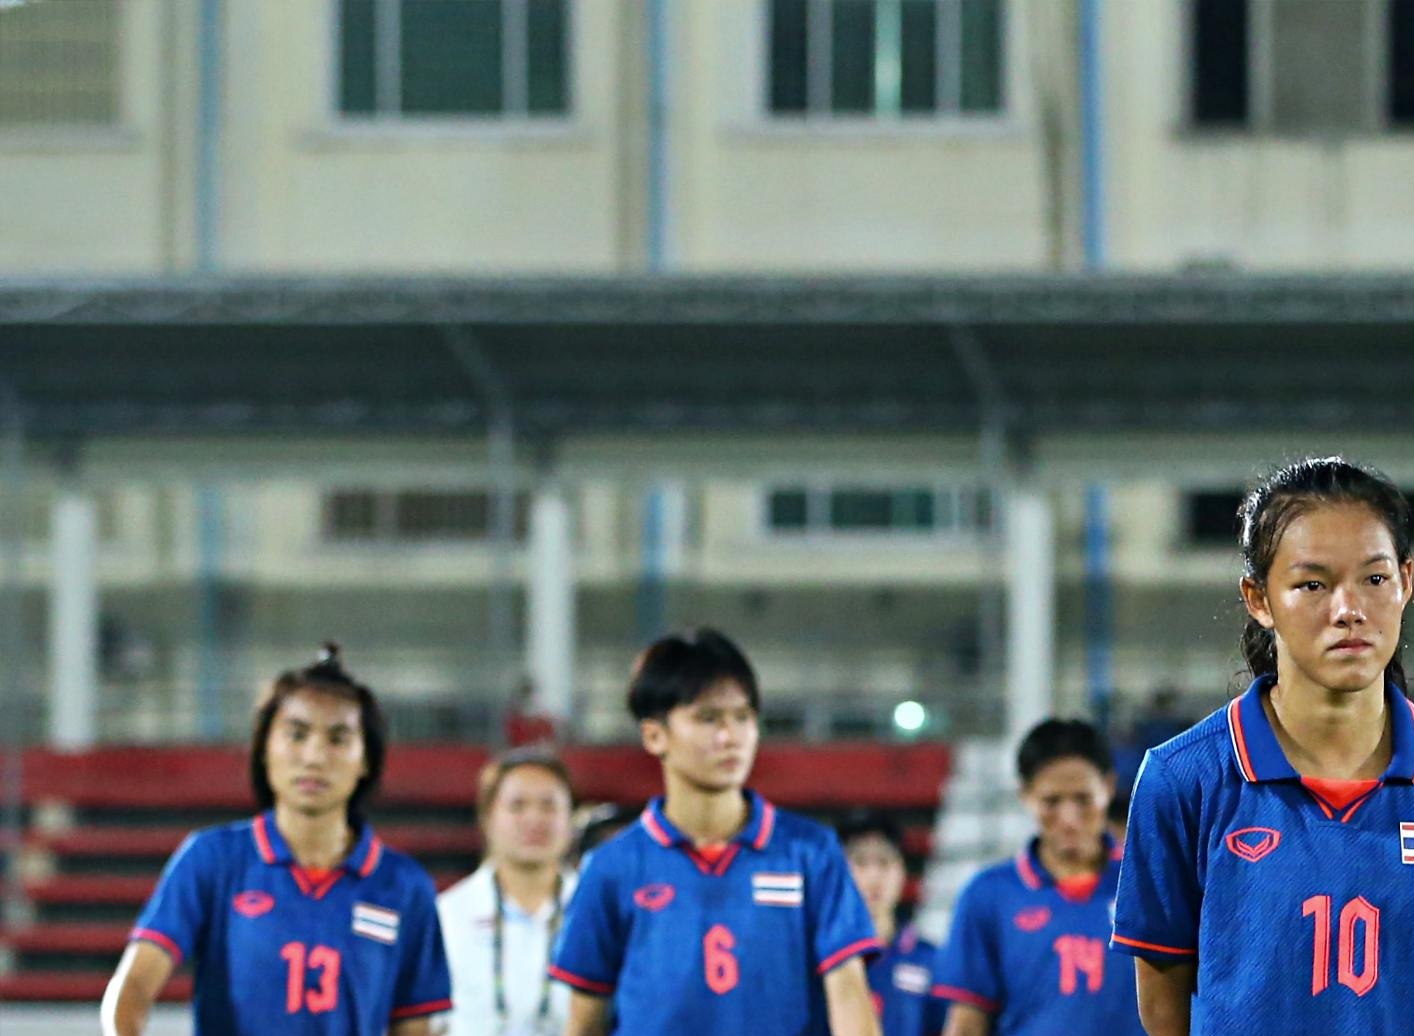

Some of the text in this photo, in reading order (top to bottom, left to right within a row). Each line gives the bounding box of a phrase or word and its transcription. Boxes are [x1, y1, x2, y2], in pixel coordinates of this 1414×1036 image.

[280, 940, 341, 1014] 13
[703, 923, 739, 995] 6
[1053, 932, 1104, 997] 14
[1302, 894, 1381, 998] 10
